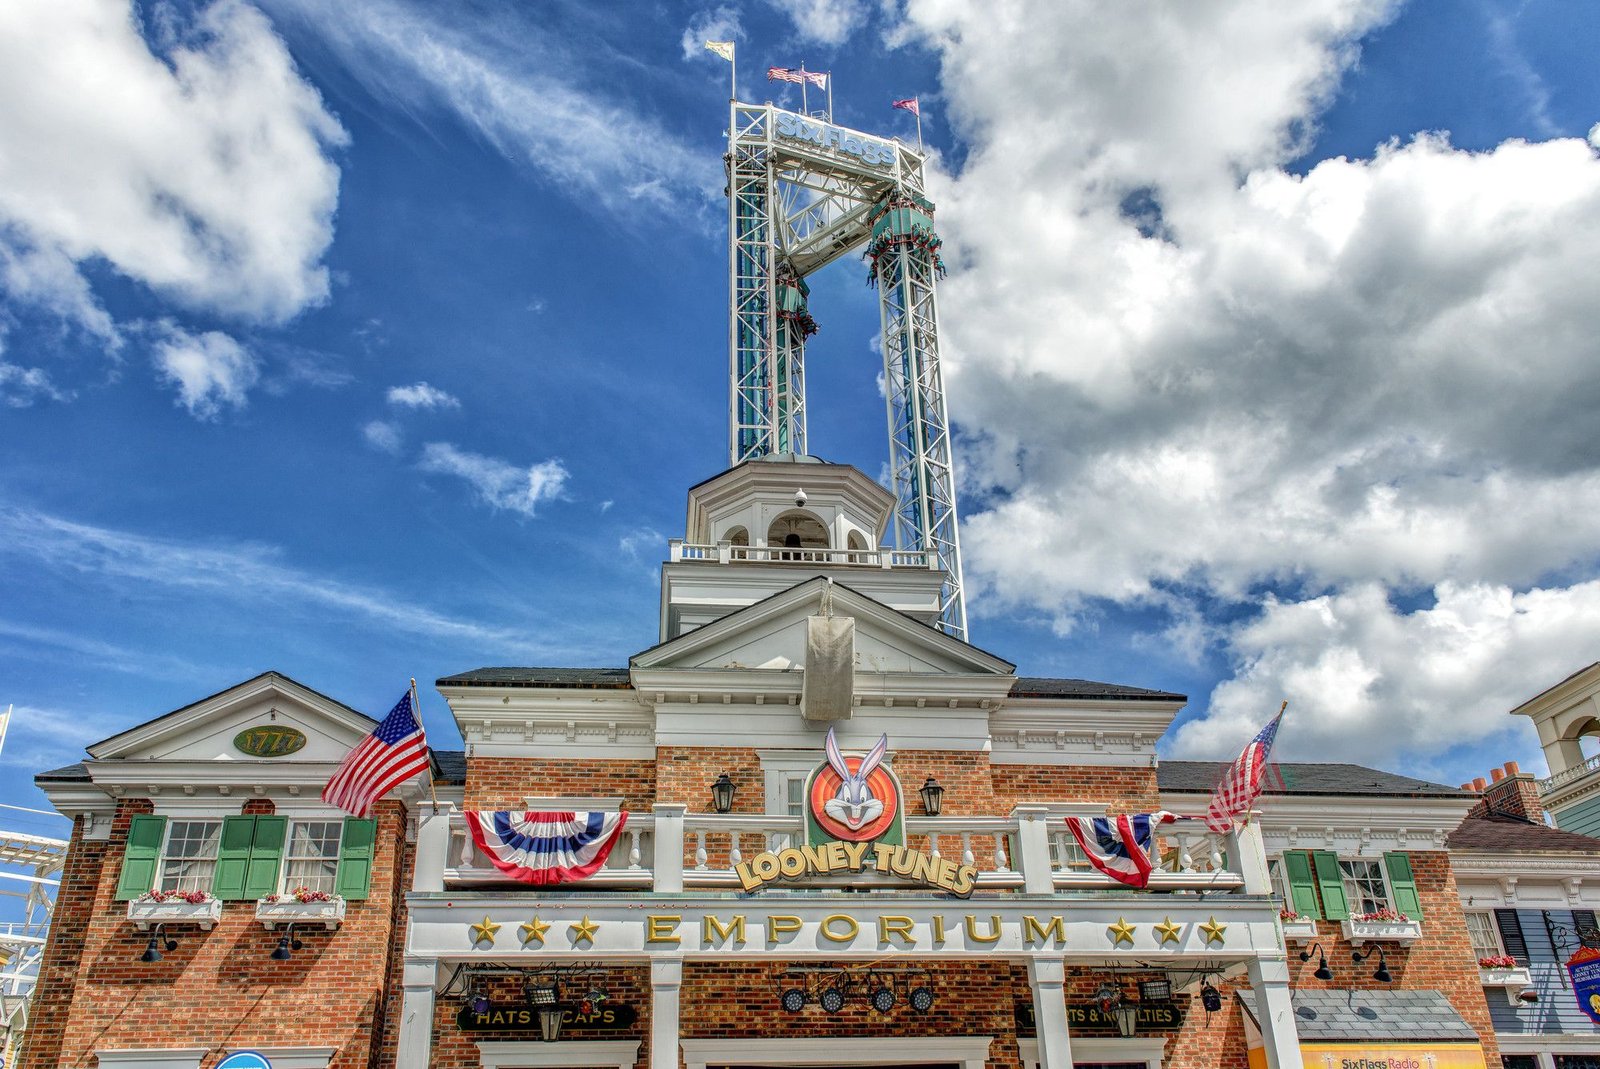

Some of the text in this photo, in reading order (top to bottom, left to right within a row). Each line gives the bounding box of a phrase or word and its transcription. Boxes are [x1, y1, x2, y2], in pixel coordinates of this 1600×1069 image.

[776, 112, 898, 166] Six Flags
[246, 730, 298, 753] 1777
[735, 841, 978, 898] LOONEY TUNES
[647, 913, 1068, 944] EMPORIUM
[476, 1010, 615, 1025] HATS CAPS
[1089, 1009, 1099, 1023] &
[1388, 1057, 1419, 1069] Radio
